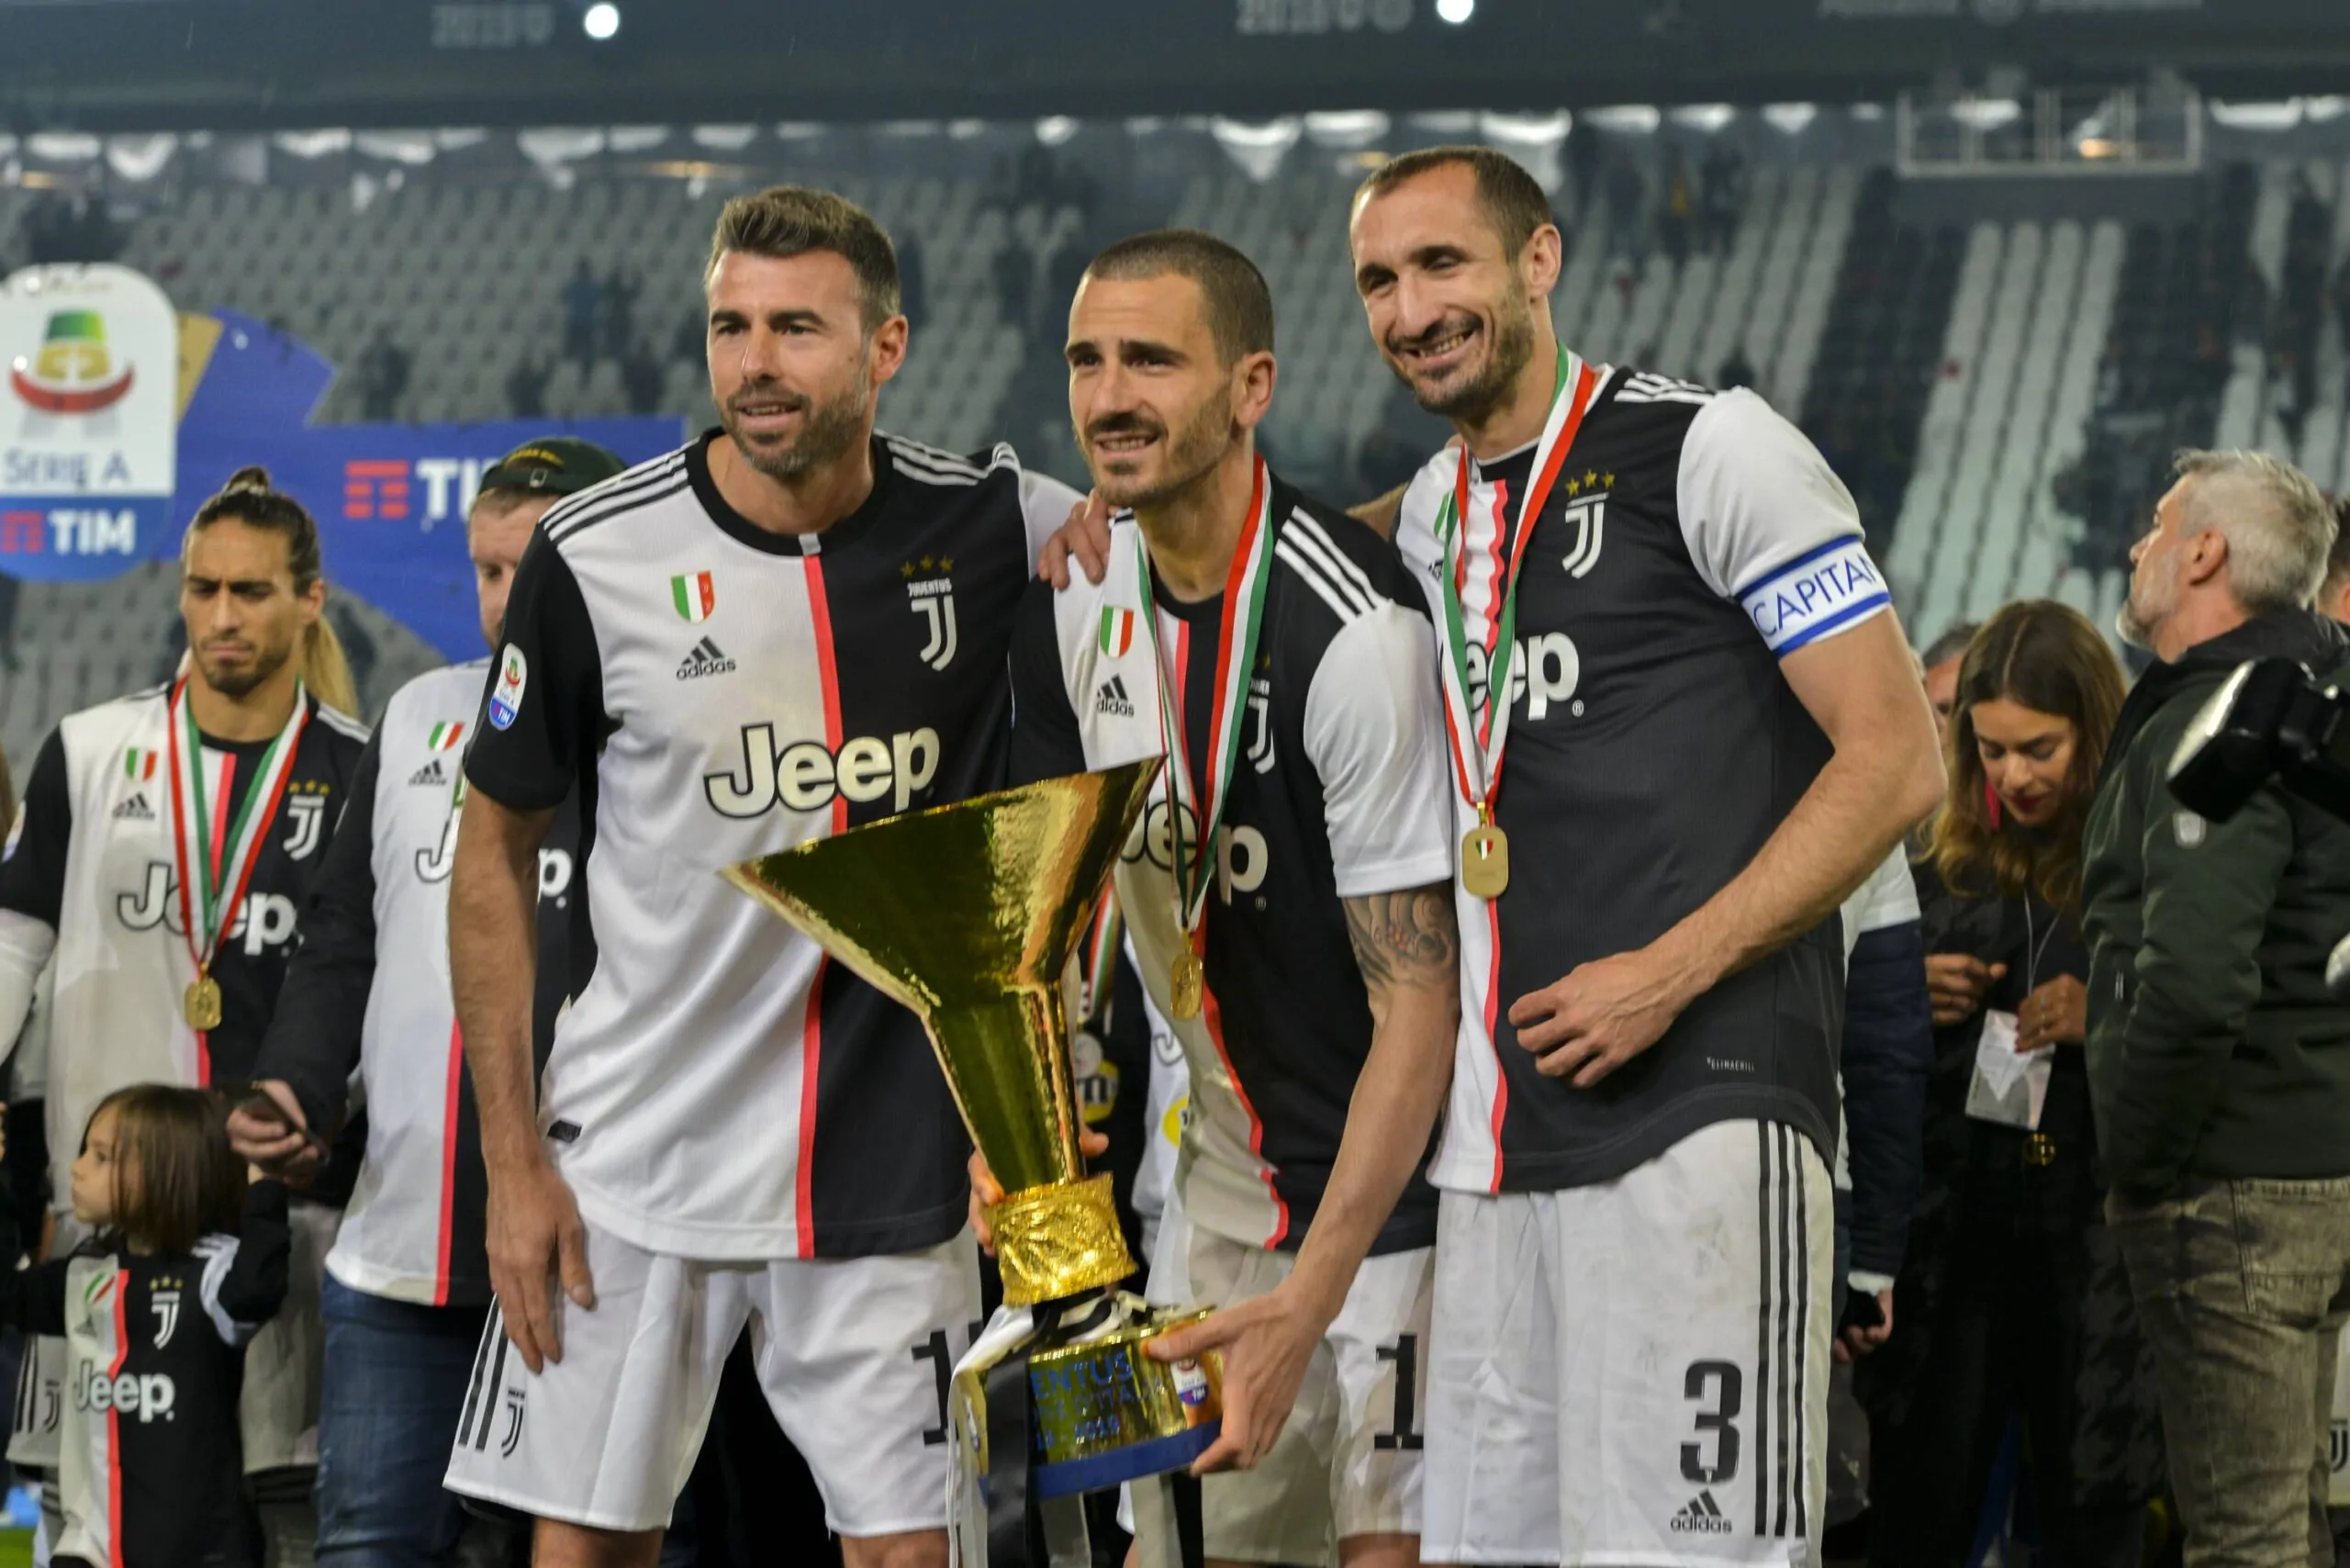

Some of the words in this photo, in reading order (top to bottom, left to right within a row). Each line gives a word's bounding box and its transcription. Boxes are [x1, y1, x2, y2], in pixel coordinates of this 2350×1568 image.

[416, 456, 500, 521] TI
[48, 509, 137, 556] TIM
[1753, 551, 1878, 638] CAPITAN
[676, 657, 737, 681] adidas
[703, 720, 941, 819] Jeep
[73, 1359, 176, 1423] Jeep
[1030, 1349, 1135, 1401] ENTUS
[1680, 1359, 1742, 1484] 3
[1670, 1516, 1733, 1535] adidas
